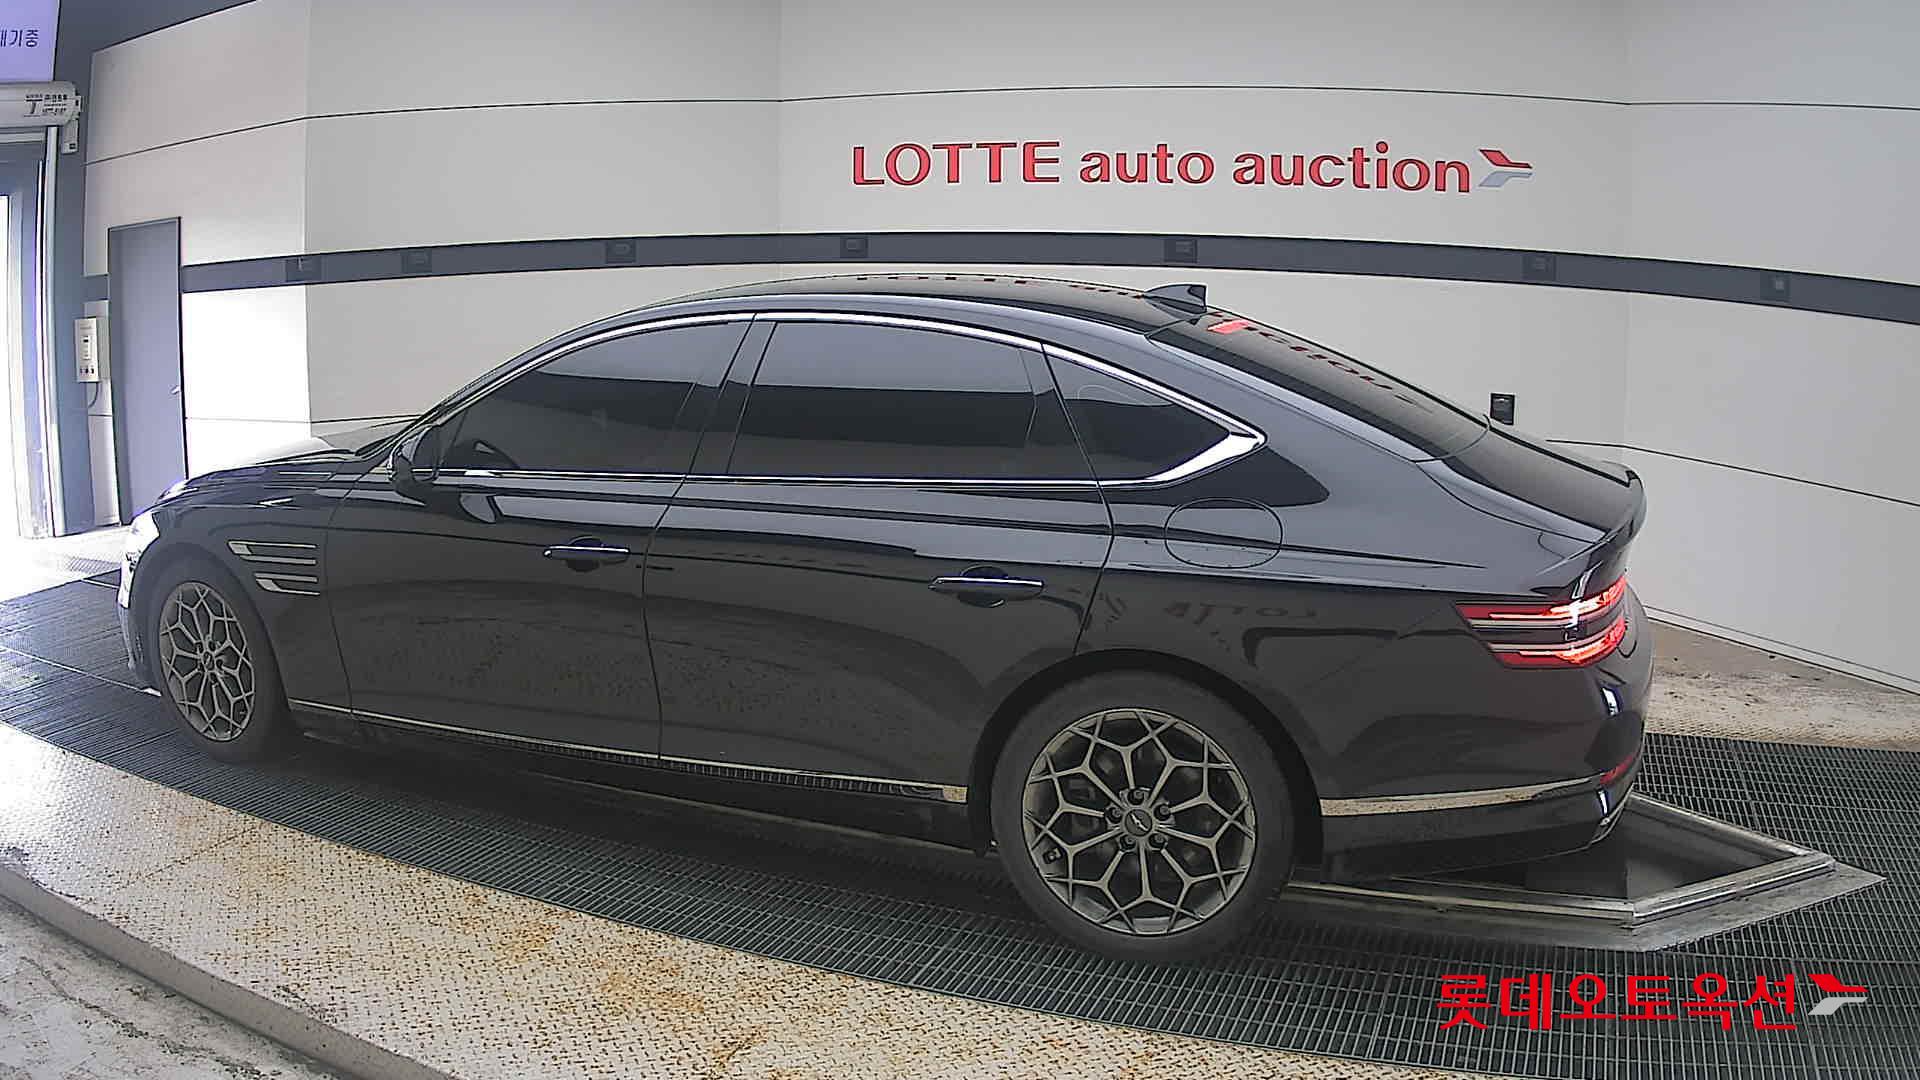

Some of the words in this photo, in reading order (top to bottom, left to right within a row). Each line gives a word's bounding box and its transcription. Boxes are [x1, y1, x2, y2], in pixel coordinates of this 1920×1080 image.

[852, 141, 1060, 186] LOTTE
[1079, 143, 1215, 185] auto
[1233, 141, 1470, 193] auction
